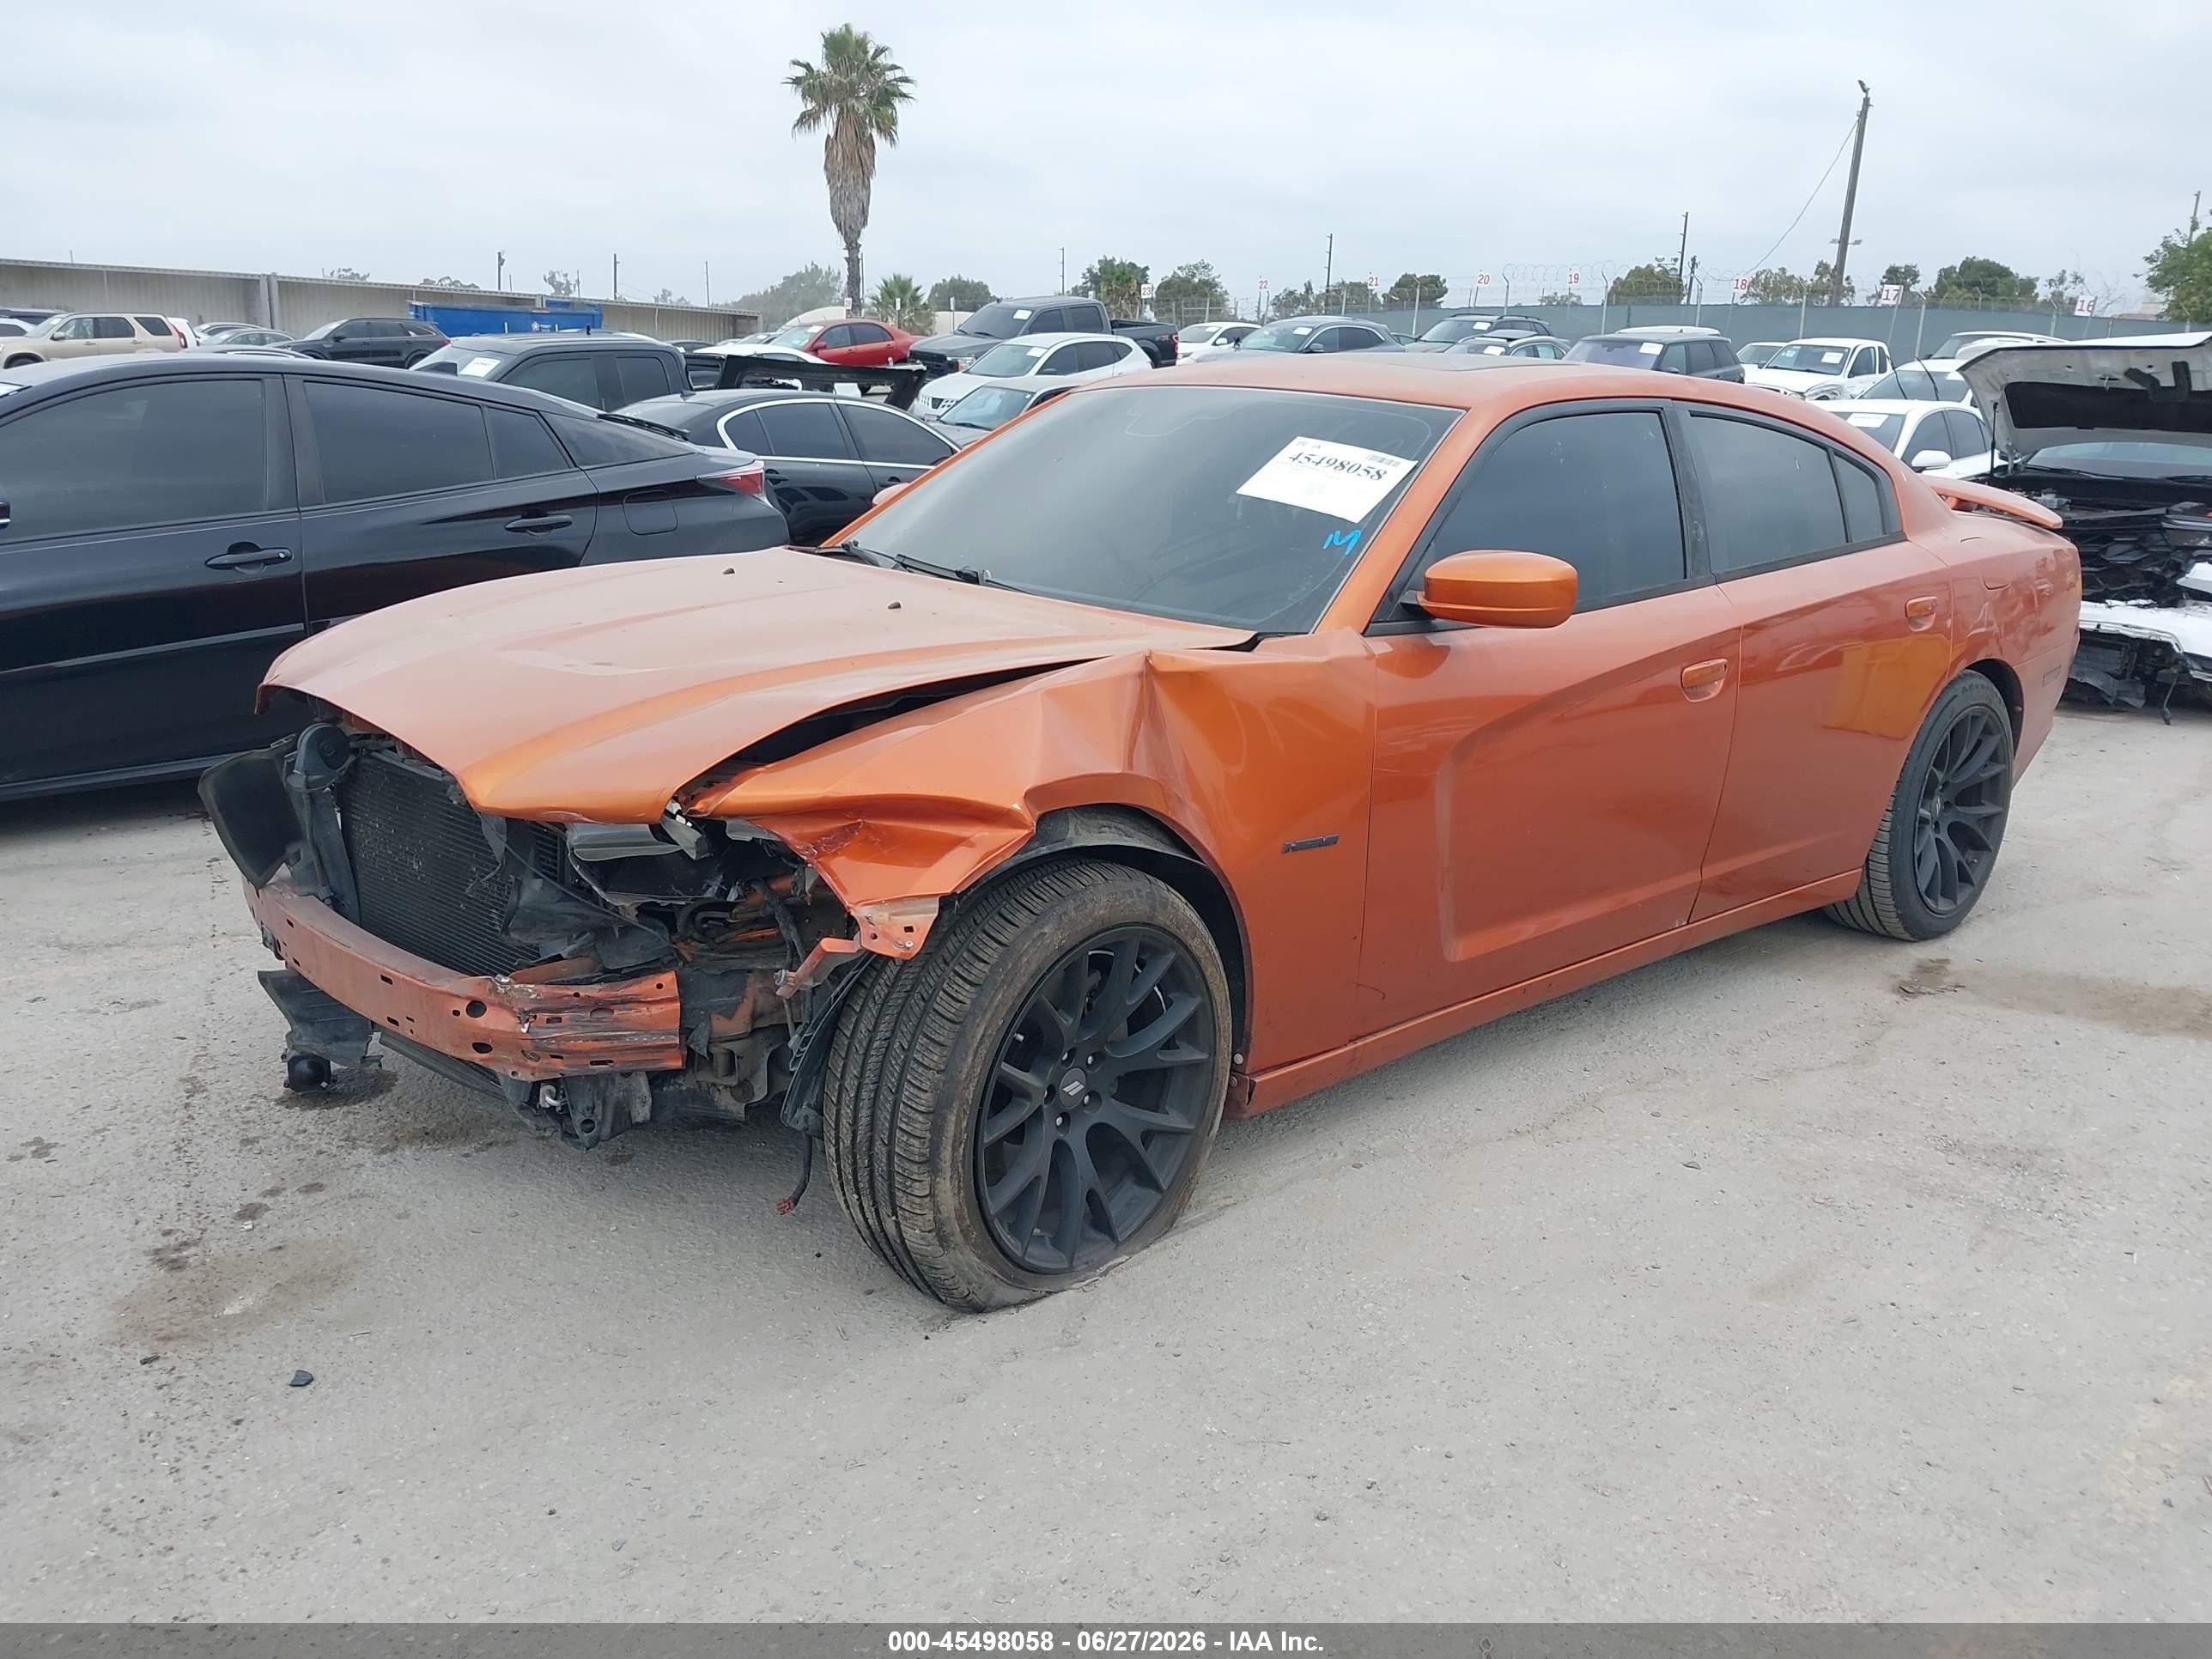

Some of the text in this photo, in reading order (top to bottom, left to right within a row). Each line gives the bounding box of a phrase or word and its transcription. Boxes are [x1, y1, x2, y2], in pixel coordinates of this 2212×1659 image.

[1368, 276, 1379, 287] 21
[1477, 274, 1490, 285] 20
[1567, 273, 1580, 284] 19
[1733, 278, 1747, 290] 18
[1259, 280, 1268, 289] 22
[1142, 287, 1152, 296] 23
[1883, 288, 1900, 301] 17
[2076, 299, 2095, 313] 16
[1288, 452, 1388, 481] 45498058
